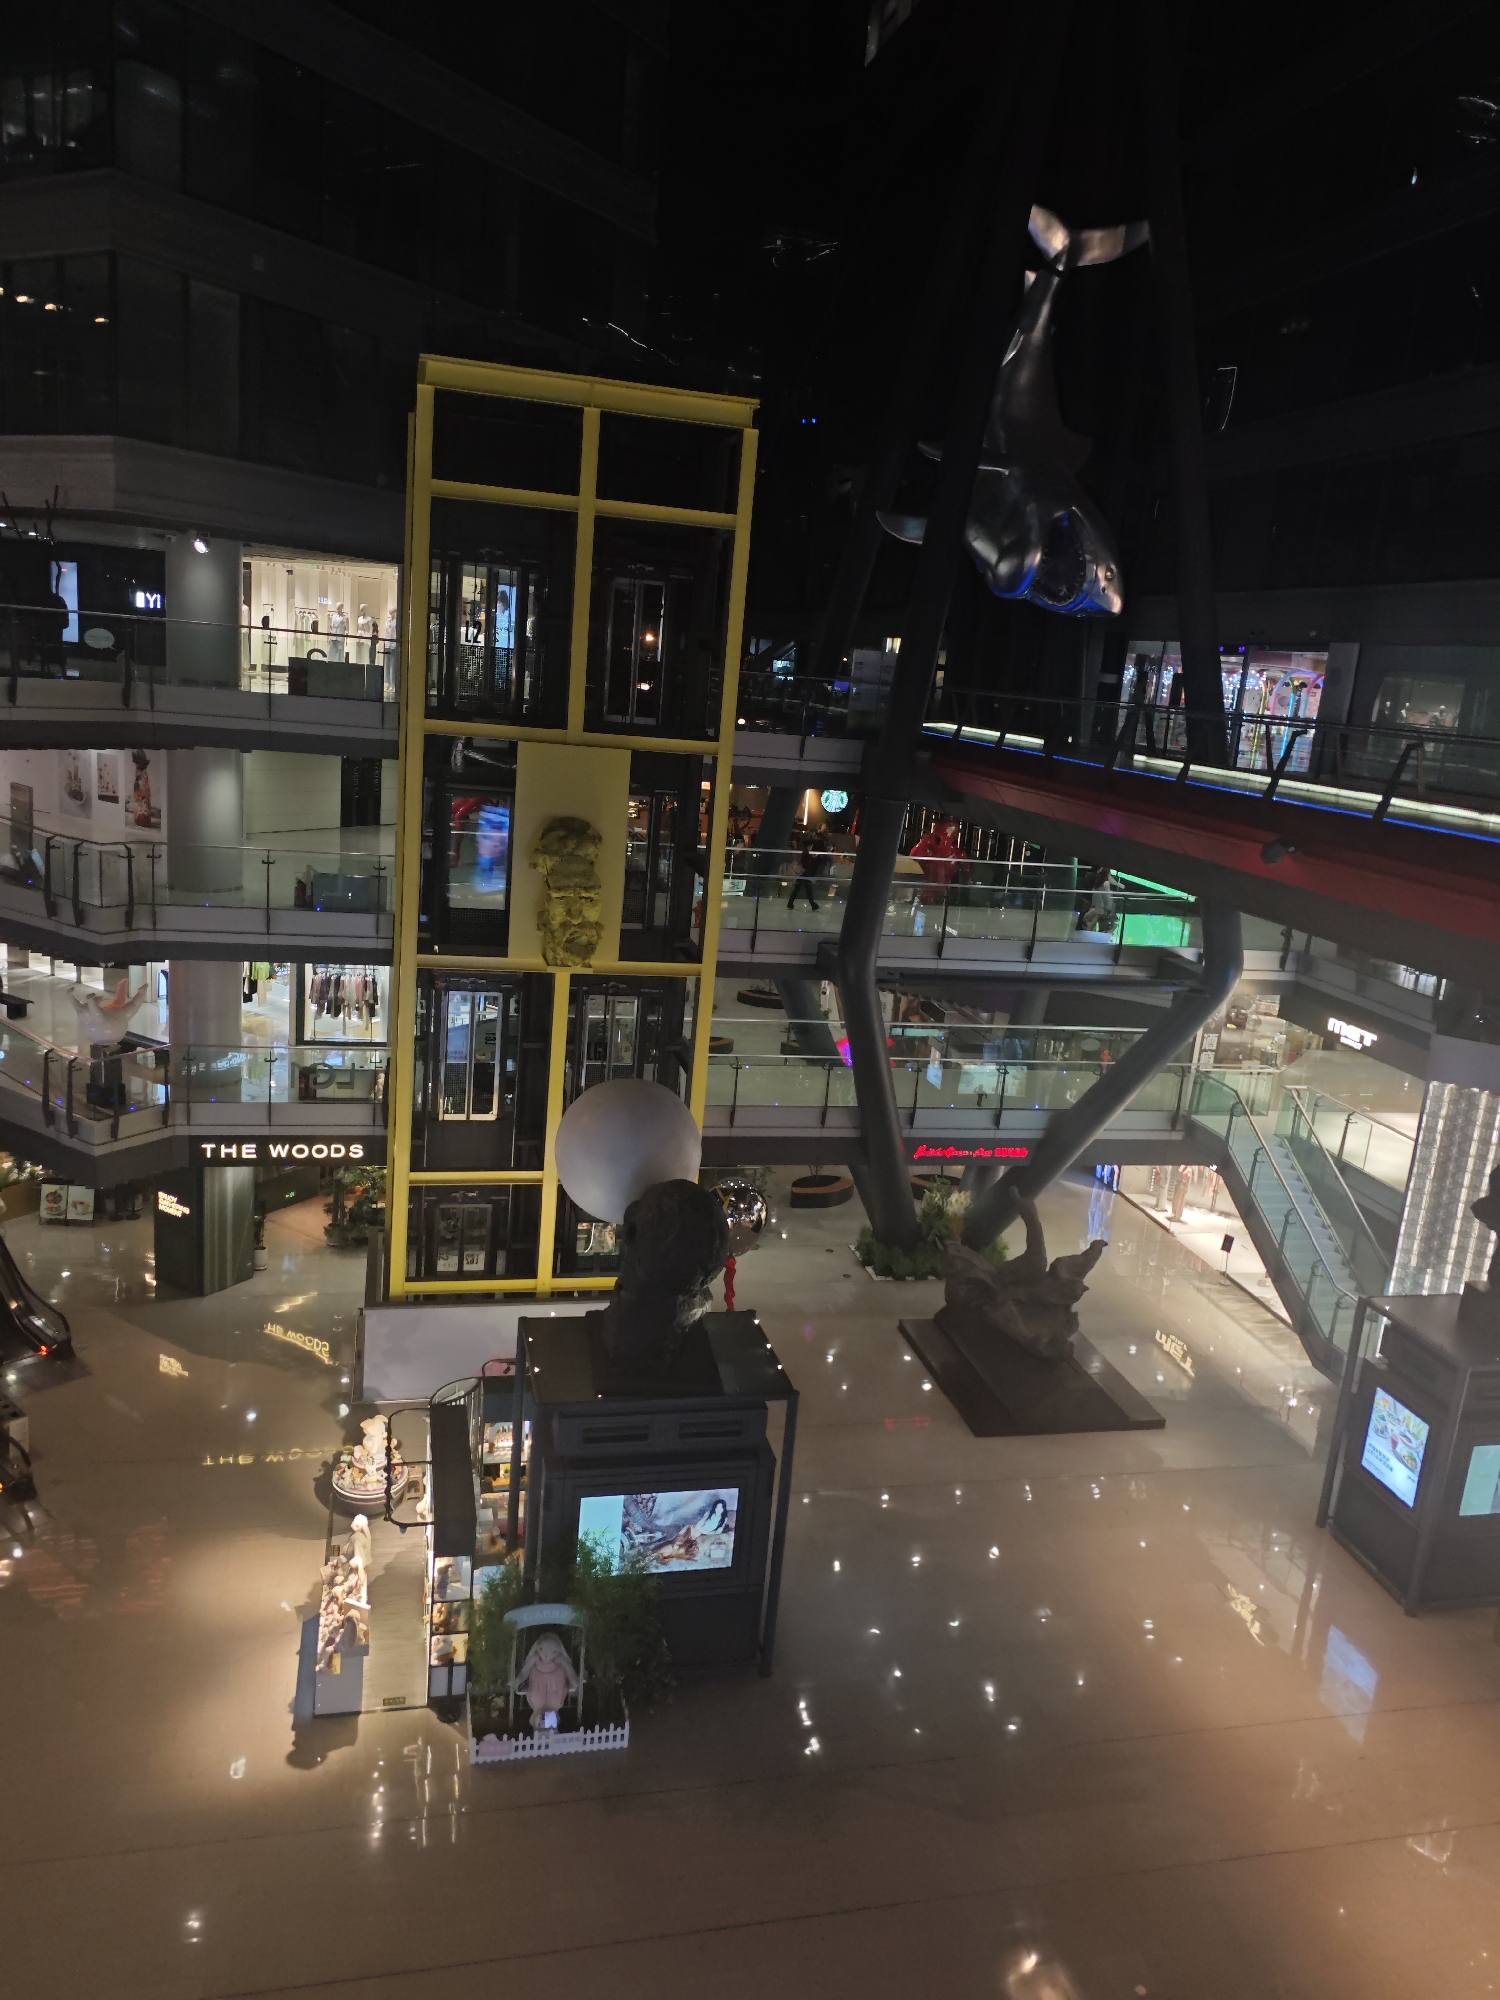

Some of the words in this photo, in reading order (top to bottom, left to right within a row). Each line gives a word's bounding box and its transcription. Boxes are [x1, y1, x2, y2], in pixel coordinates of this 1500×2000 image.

[136, 591, 161, 608] YI
[465, 620, 482, 643] L2
[201, 1143, 257, 1158] THE
[268, 1143, 364, 1159] WOODS
